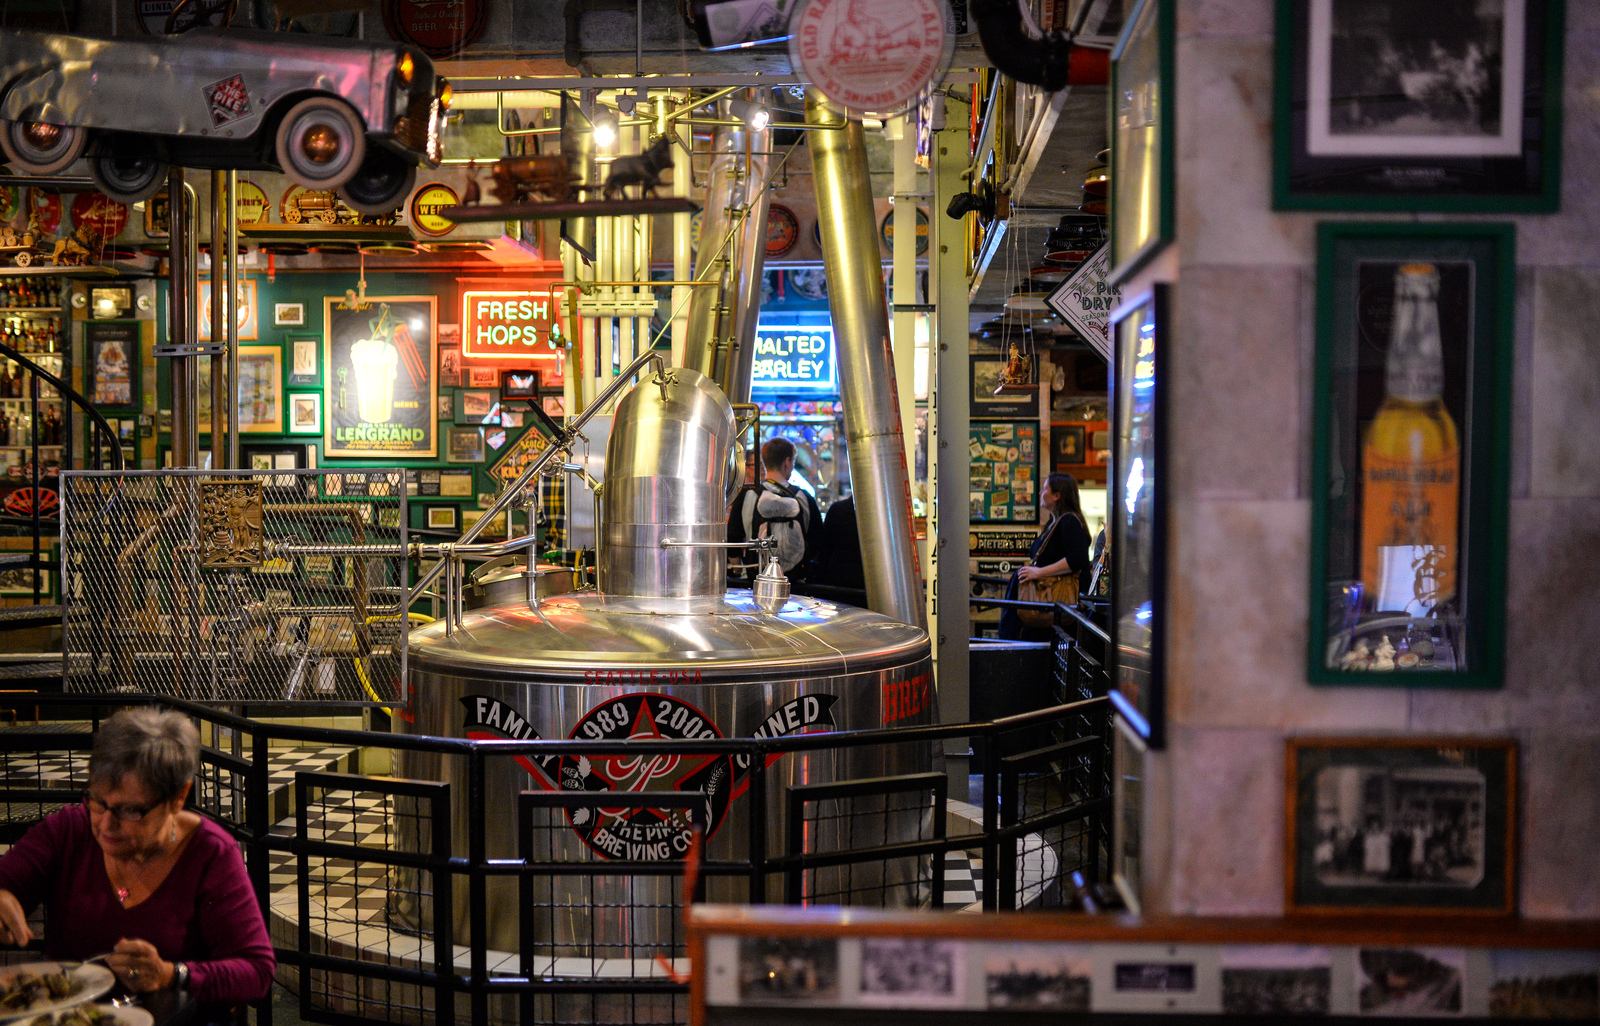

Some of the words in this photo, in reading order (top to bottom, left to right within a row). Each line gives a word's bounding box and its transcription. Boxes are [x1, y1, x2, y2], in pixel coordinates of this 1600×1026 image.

[922, 13, 940, 47] ALE
[804, 24, 817, 59] OLD
[214, 91, 241, 111] PIKE
[225, 85, 241, 99] THE
[477, 301, 547, 320] FRESH
[1082, 296, 1113, 311] DRY
[1081, 311, 1111, 322] SEASONA
[477, 324, 537, 346] HOPS
[336, 427, 425, 441] LENGRAND
[574, 702, 630, 741] 989
[611, 815, 643, 840] THE
[593, 828, 671, 861] BREWING
